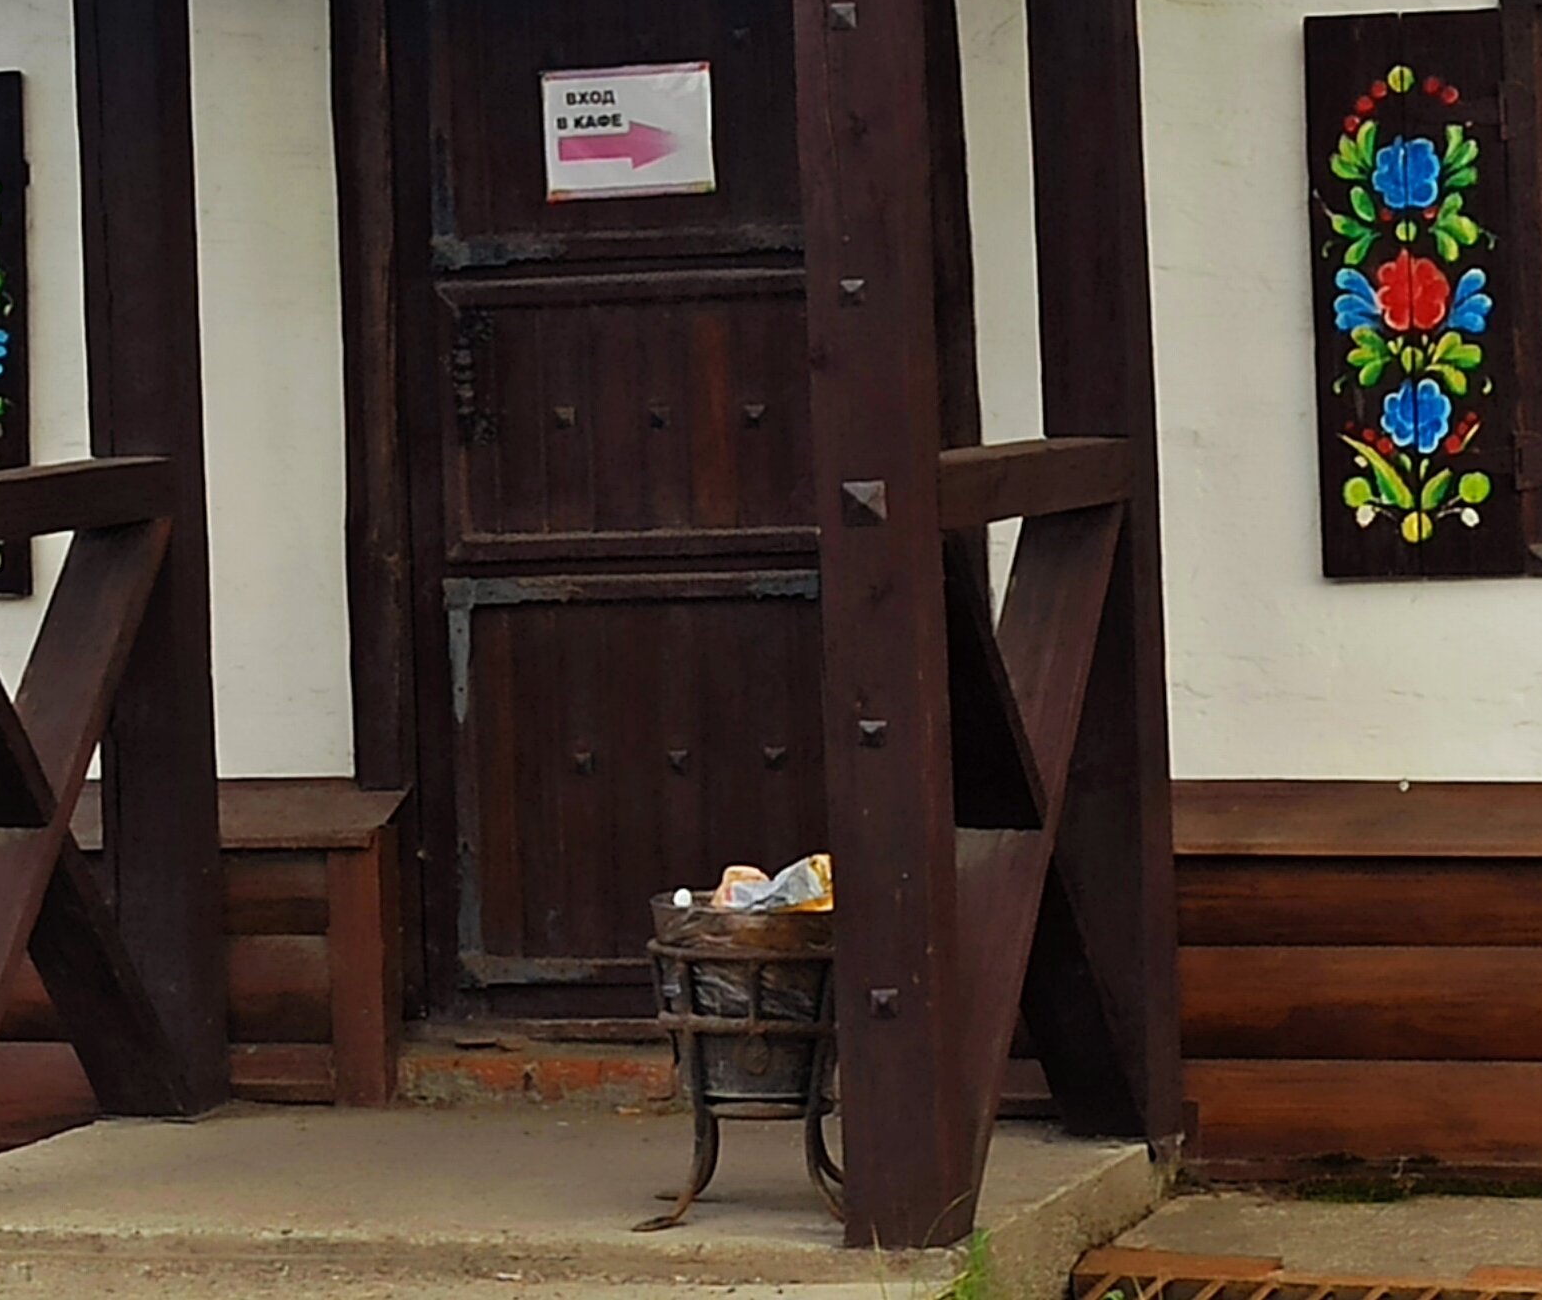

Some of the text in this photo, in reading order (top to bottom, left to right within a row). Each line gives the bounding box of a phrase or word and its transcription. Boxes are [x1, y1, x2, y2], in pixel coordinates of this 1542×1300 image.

[565, 89, 616, 106] ВХОД
[556, 113, 623, 130] В КАФЕ
